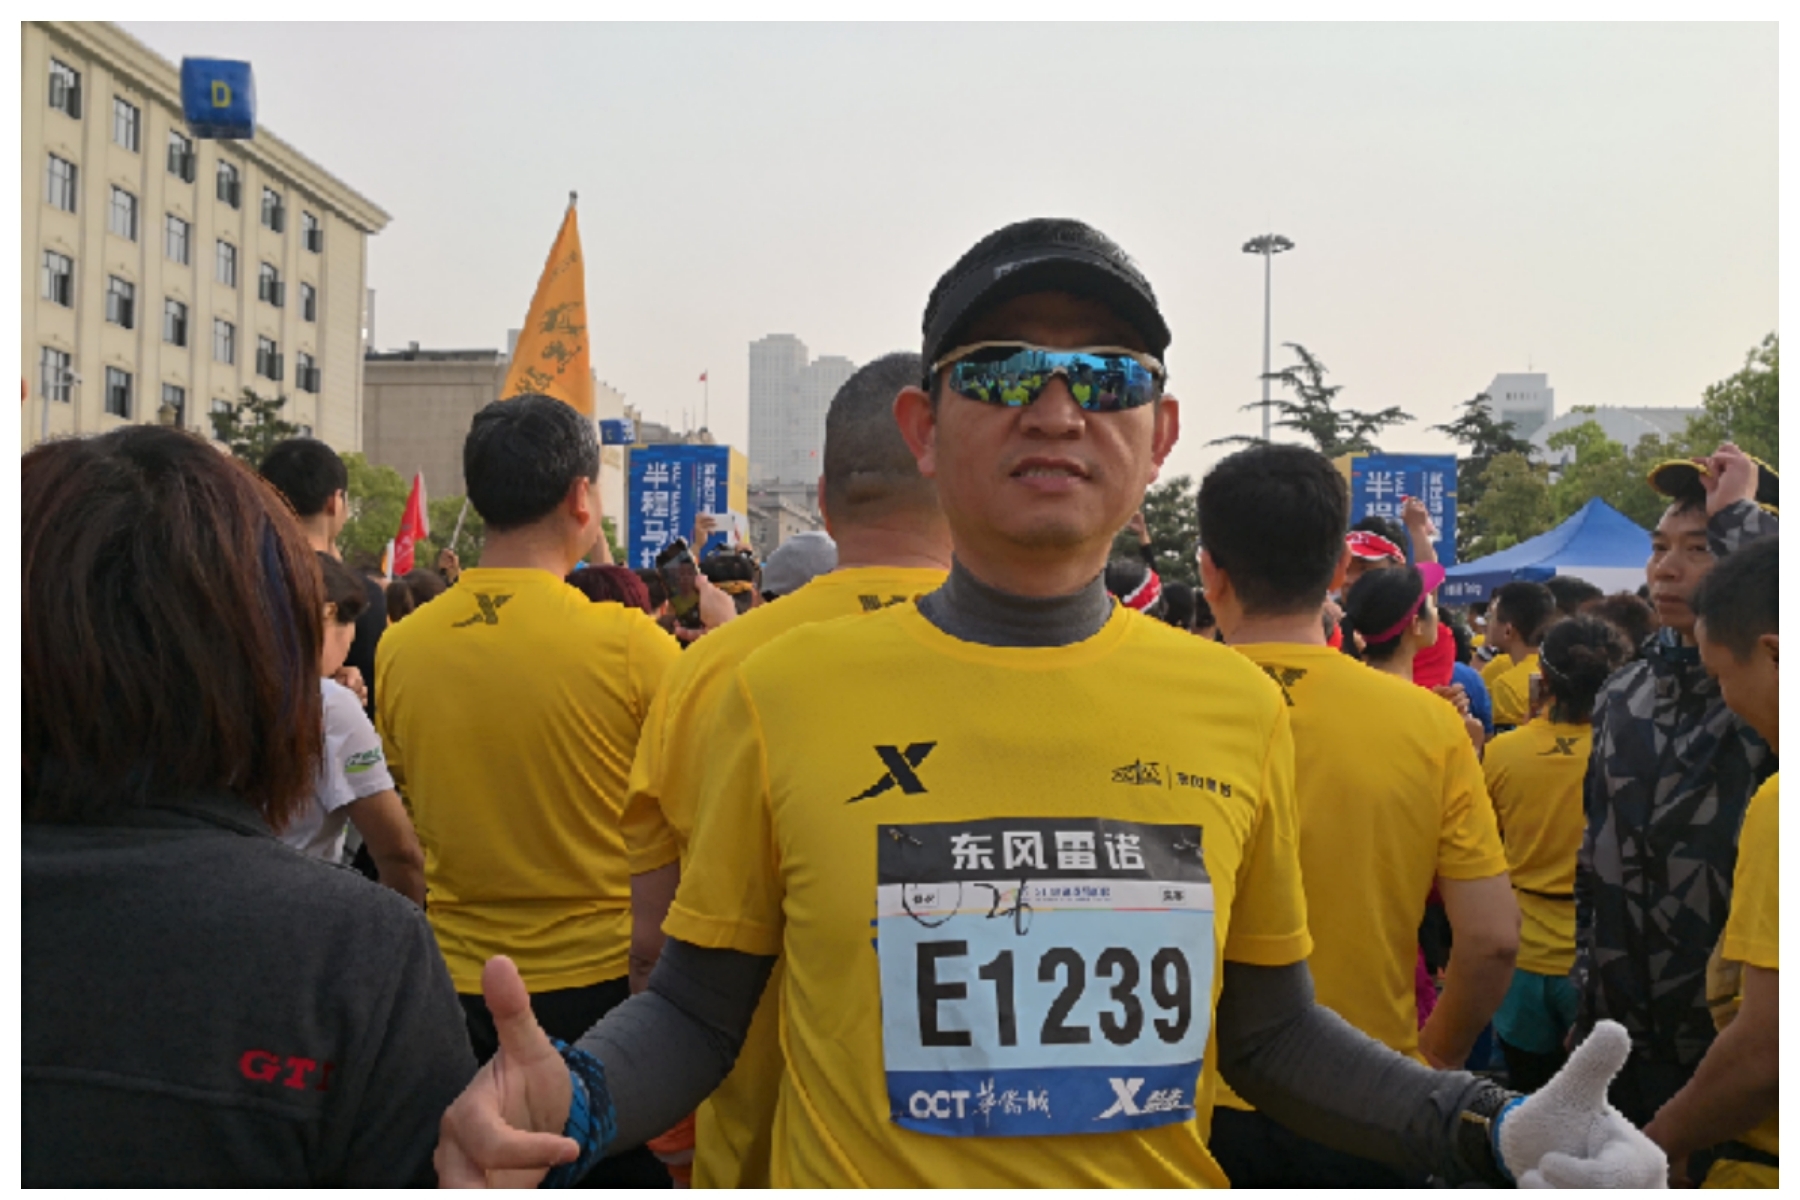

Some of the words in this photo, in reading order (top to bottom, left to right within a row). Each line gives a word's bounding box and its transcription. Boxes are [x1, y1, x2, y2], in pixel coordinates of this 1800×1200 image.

[212, 80, 232, 108] D
[950, 831, 1146, 870] 东风雷诺
[916, 940, 1192, 1047] E1239
[909, 1090, 970, 1118] OCT
